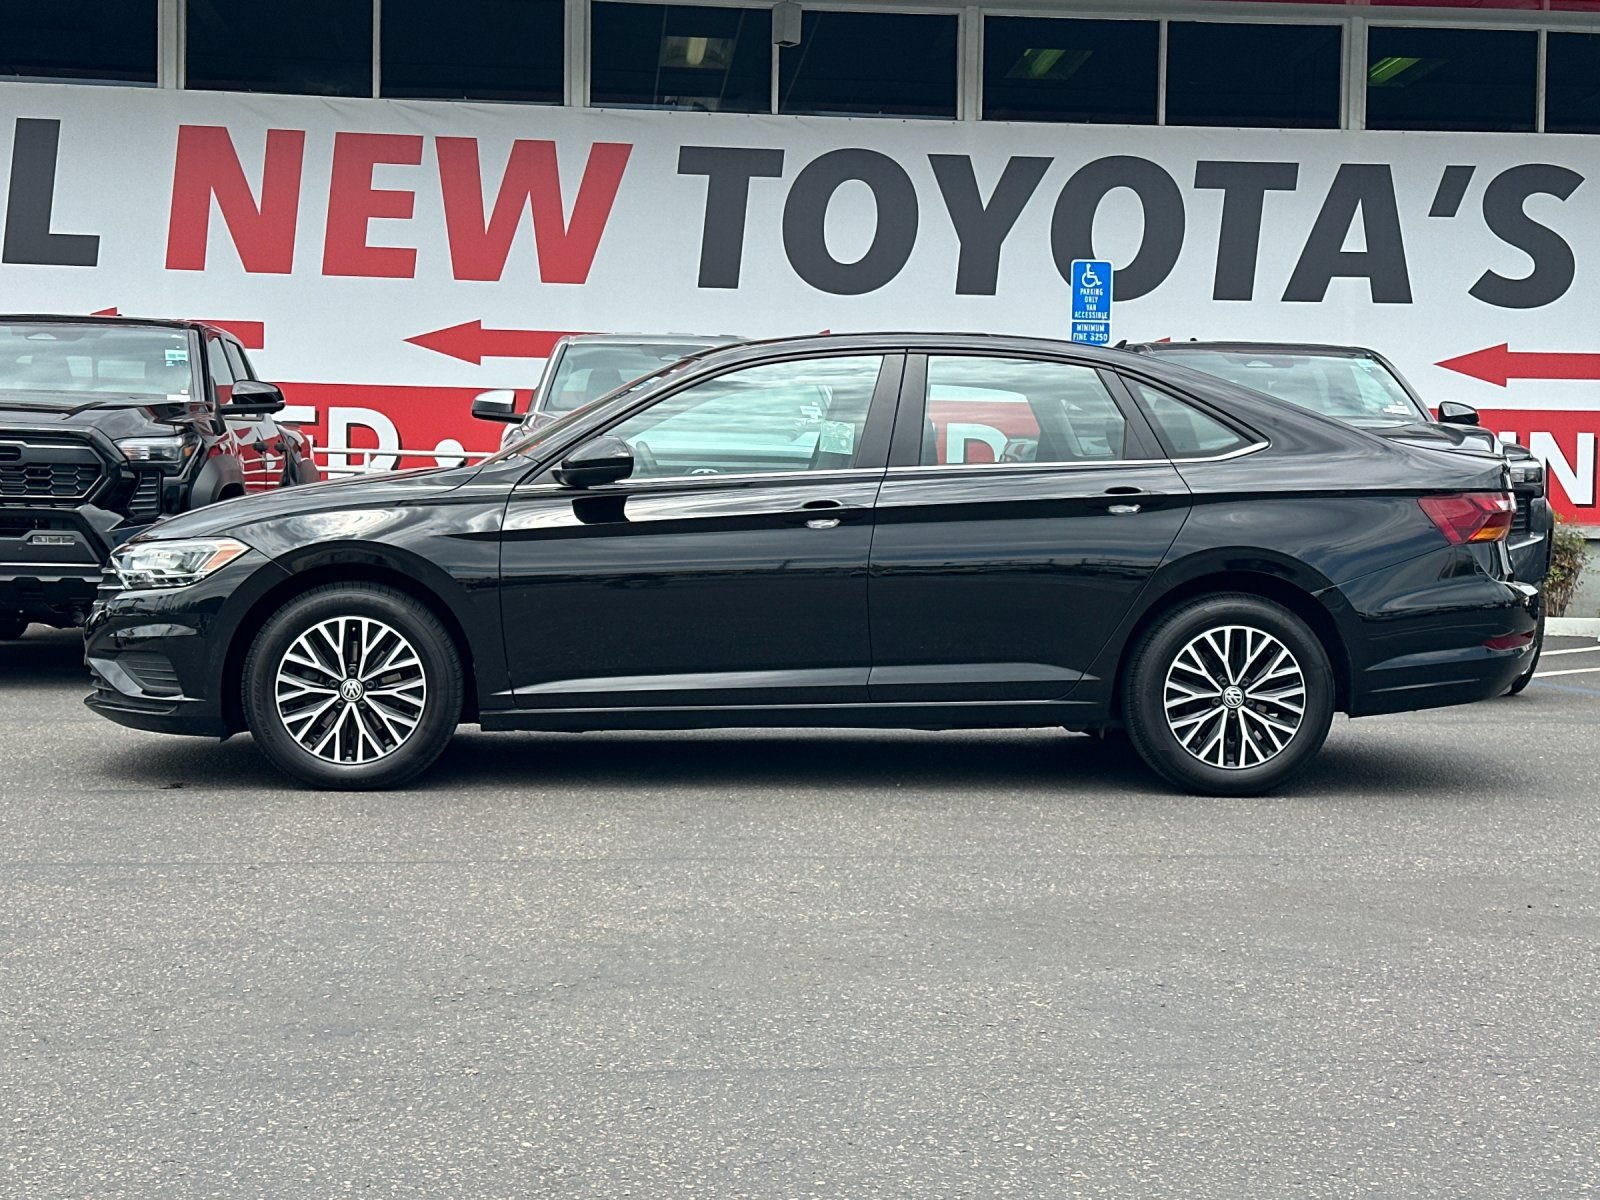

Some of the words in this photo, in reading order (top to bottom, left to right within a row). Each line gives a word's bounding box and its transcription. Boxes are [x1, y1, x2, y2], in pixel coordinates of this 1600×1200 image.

[2, 117, 100, 267] L
[165, 124, 634, 285] NEW
[677, 145, 1586, 310] TOYOTA'S
[1080, 287, 1104, 296] PARKING
[1084, 295, 1099, 303] ONLY
[1086, 303, 1097, 311] VAN
[1074, 311, 1108, 319] ACCESSIBLE
[1076, 323, 1105, 332] MINIMUM
[1072, 332, 1088, 341] FINE
